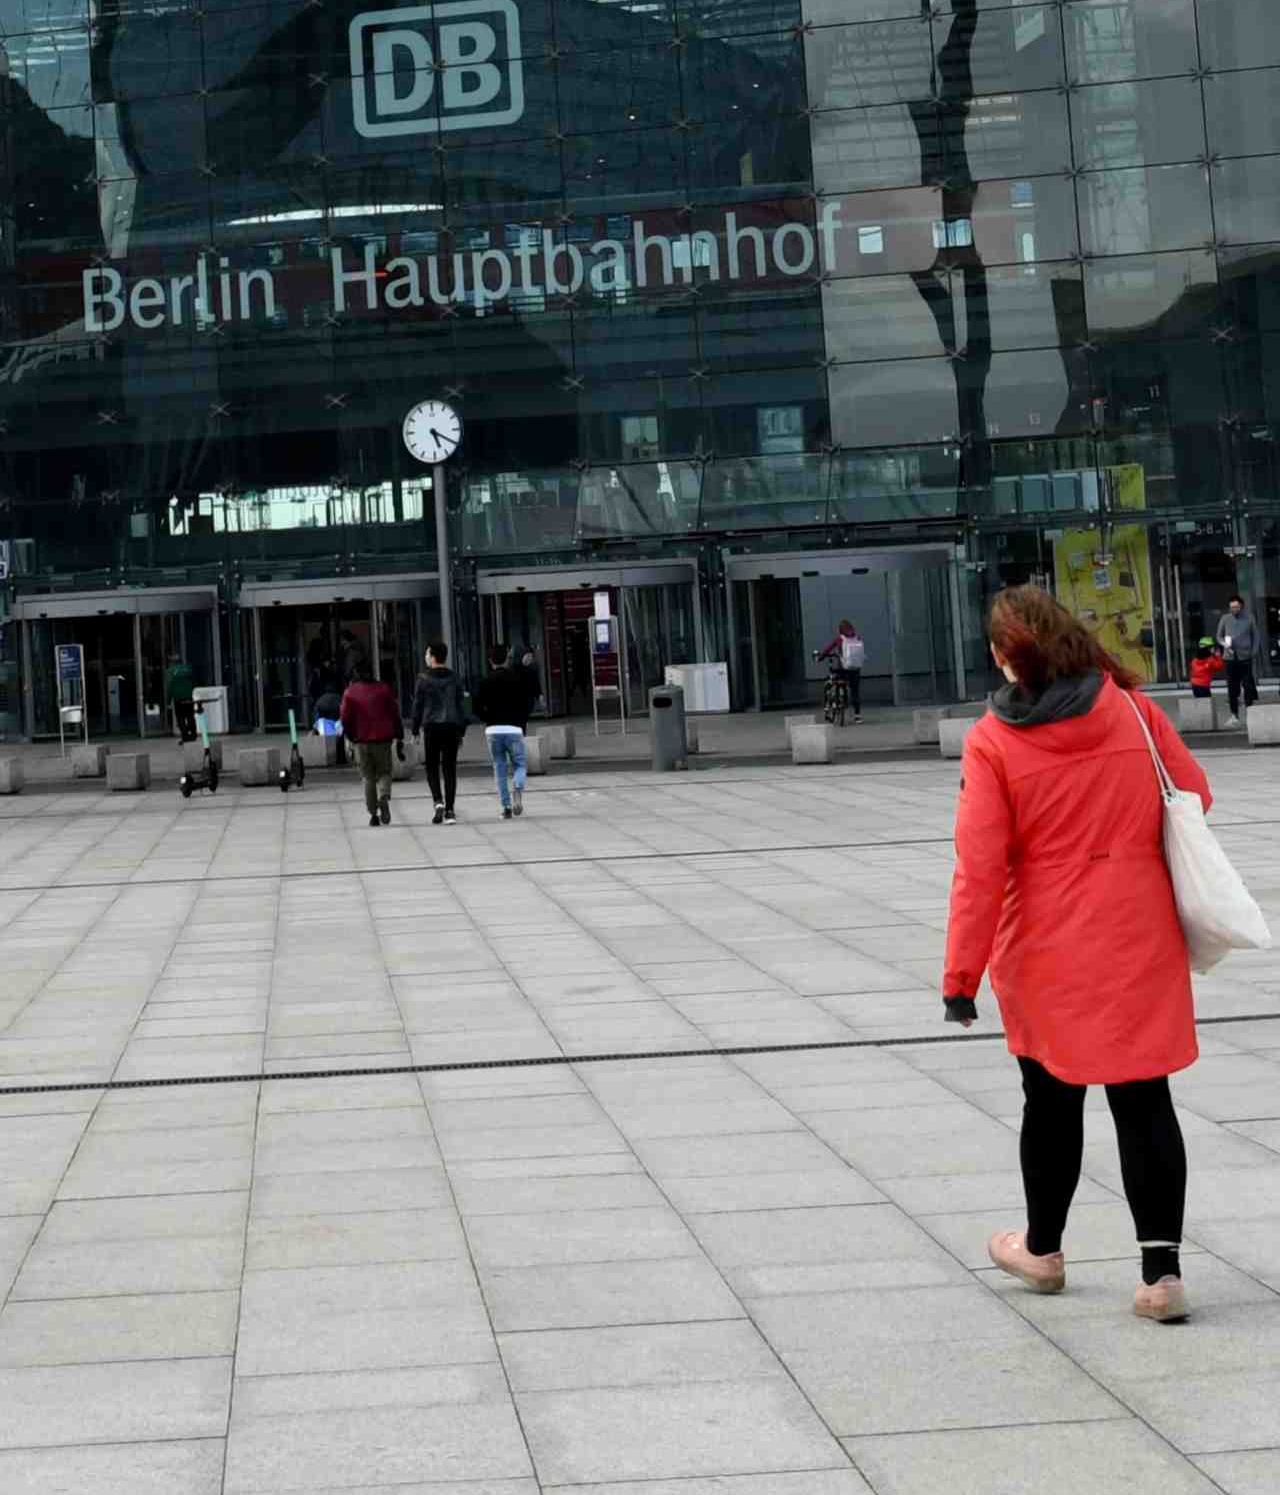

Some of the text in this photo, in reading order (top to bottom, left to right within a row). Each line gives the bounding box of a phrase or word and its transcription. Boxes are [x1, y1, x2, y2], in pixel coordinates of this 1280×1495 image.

[370, 18, 504, 118] DB
[82, 199, 845, 334] Berlin Hauptbahnhof
